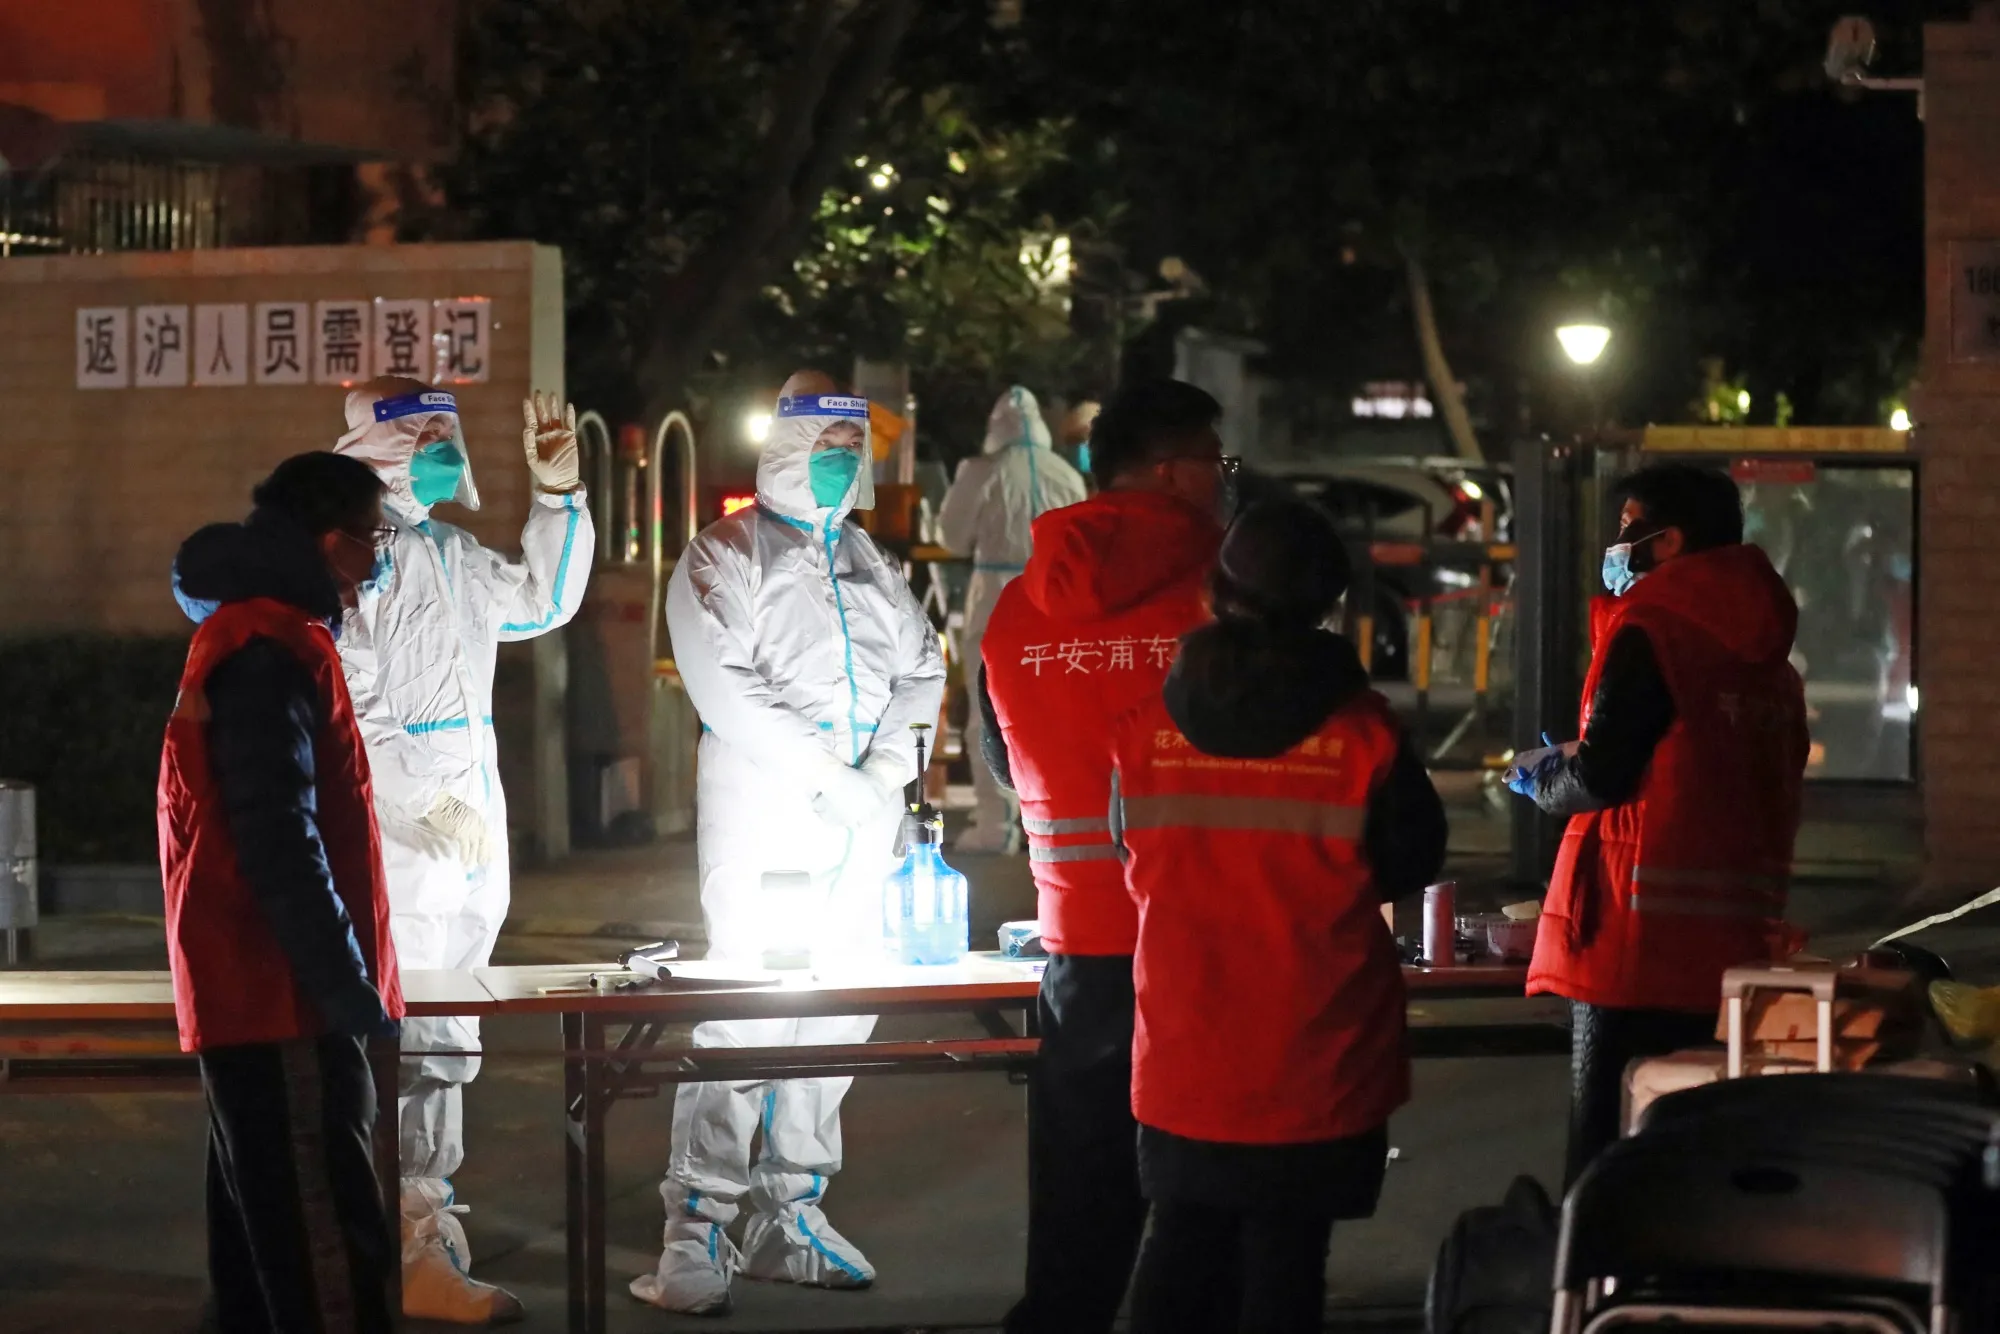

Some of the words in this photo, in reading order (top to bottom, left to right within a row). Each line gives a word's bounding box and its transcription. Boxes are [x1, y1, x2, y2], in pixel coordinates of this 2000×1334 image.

[84, 307, 482, 378] 返沪人员需登记
[427, 394, 446, 403] Face
[827, 398, 848, 408] Face
[1020, 633, 1181, 677] 平安浦东
